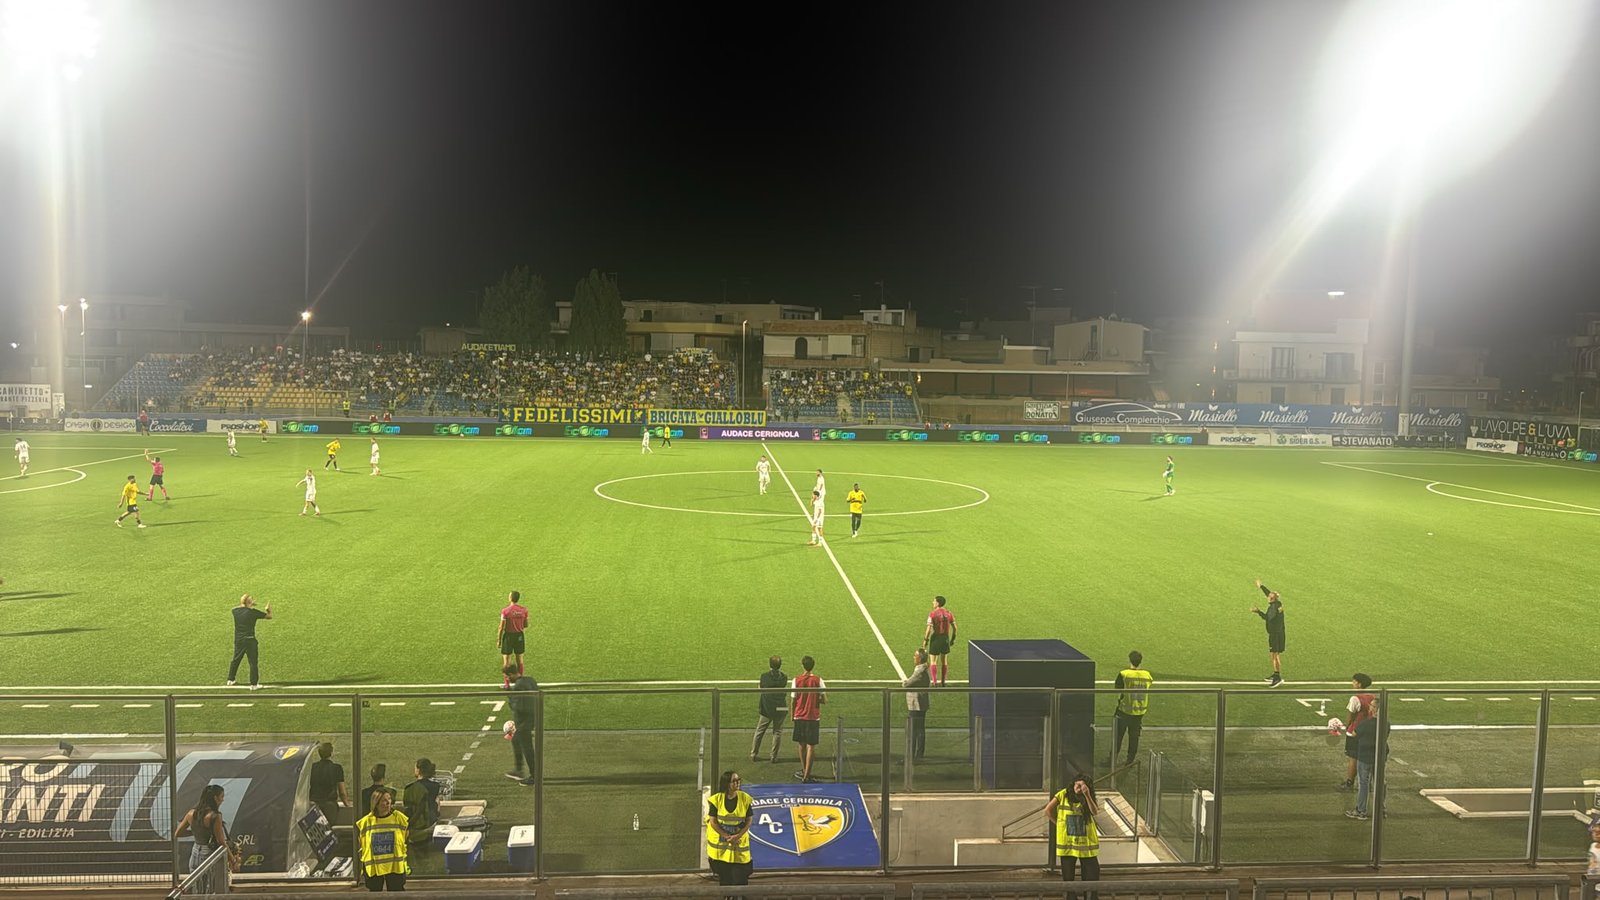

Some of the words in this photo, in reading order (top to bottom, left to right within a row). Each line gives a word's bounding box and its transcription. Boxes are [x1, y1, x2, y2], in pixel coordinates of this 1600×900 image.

[0, 387, 43, 395] AMINETTO
[513, 407, 631, 424] FEDELISSIMI
[650, 411, 696, 424] BRIGATA
[704, 412, 764, 425] GIALLOBLU
[1075, 412, 1116, 424] Giuseppe
[1188, 409, 1238, 422] Masiello
[1259, 410, 1309, 423] Masiello
[1330, 411, 1383, 425] Masiello
[104, 421, 135, 429] DESIGN
[1528, 423, 1536, 436] &
[721, 430, 753, 438] AUDACE
[754, 430, 799, 438] CERIGNOLA
[1342, 437, 1393, 446] STEVANATO
[1476, 441, 1506, 449] PROSHOP
[751, 798, 780, 806] DACE
[783, 797, 842, 807] CERIGNOLA
[19, 828, 75, 839] EDILIZIA
[237, 834, 255, 846] SRL
